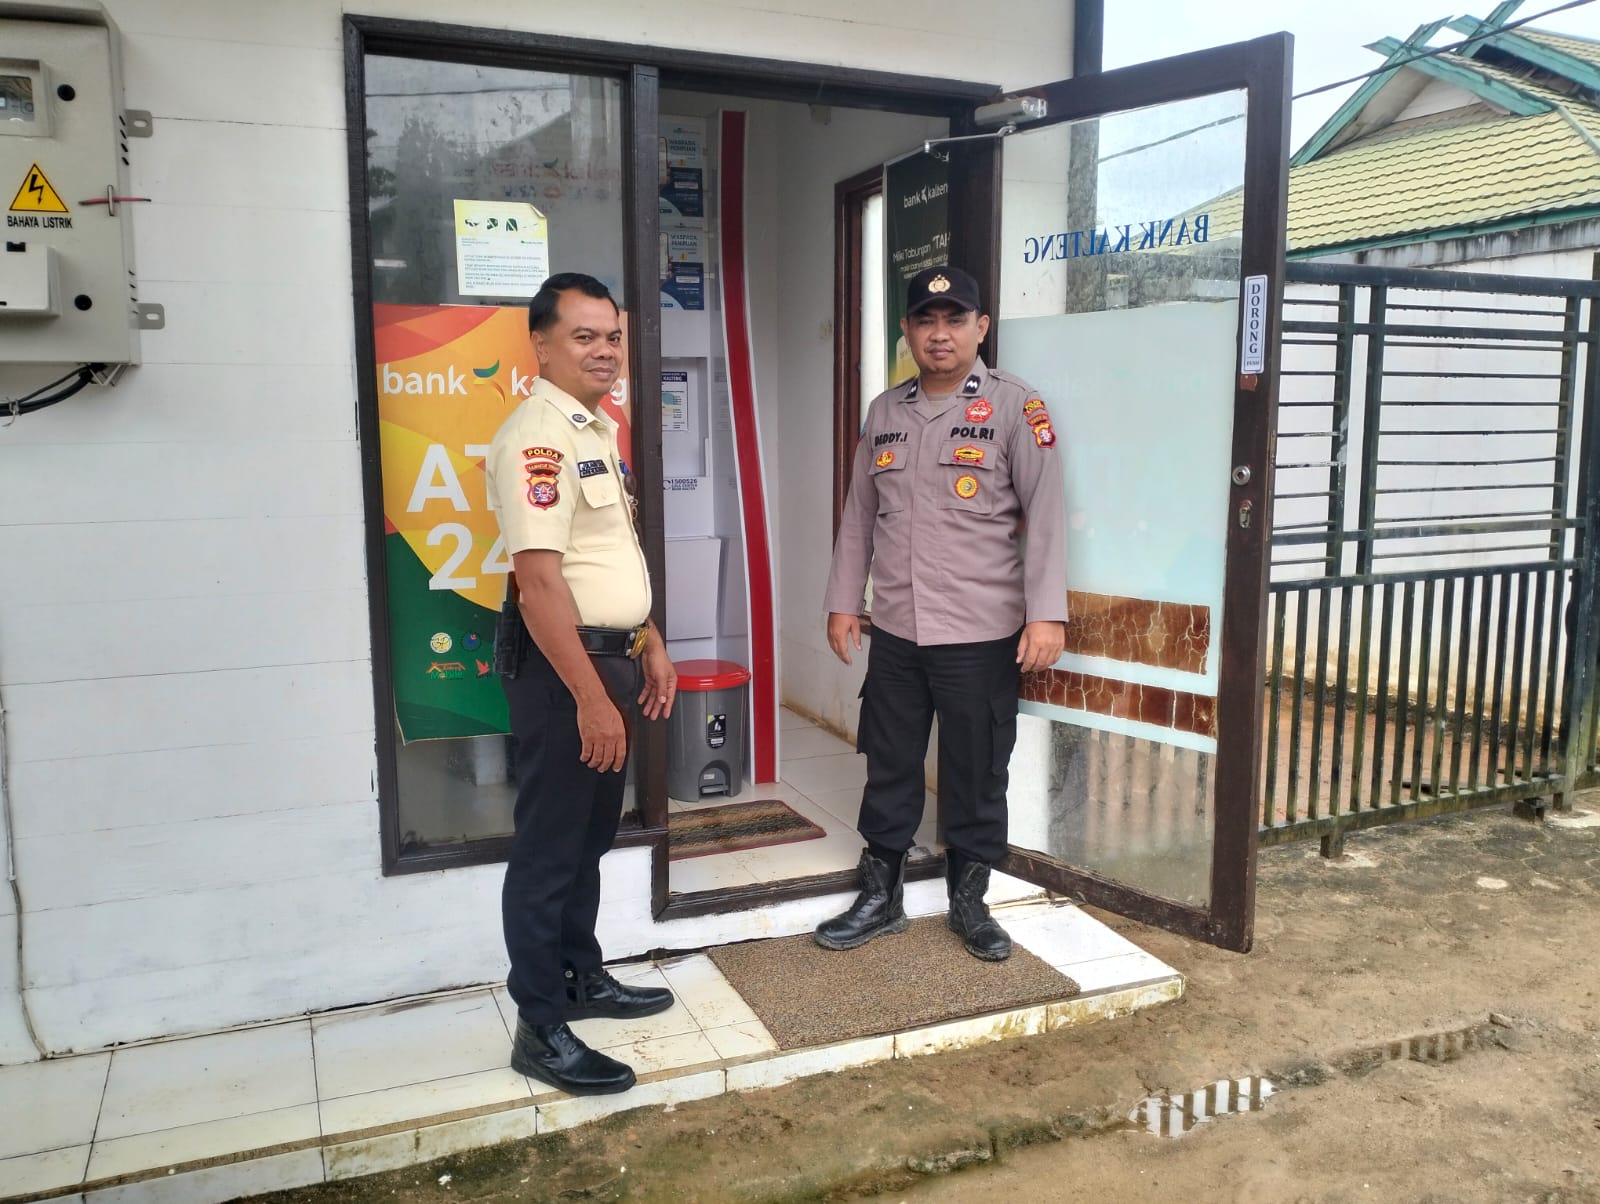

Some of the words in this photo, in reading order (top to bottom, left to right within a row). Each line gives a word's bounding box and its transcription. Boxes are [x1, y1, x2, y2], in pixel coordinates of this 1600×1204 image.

[903, 191, 921, 208] bank
[927, 183, 948, 200] kalten
[7, 215, 39, 228] BAHAYA
[42, 216, 73, 229] LISTRIK
[1249, 283, 1261, 354] DORONG
[382, 362, 468, 395] bank
[950, 426, 995, 441] POLRI
[527, 448, 559, 460] POLDA
[406, 444, 499, 513] AT
